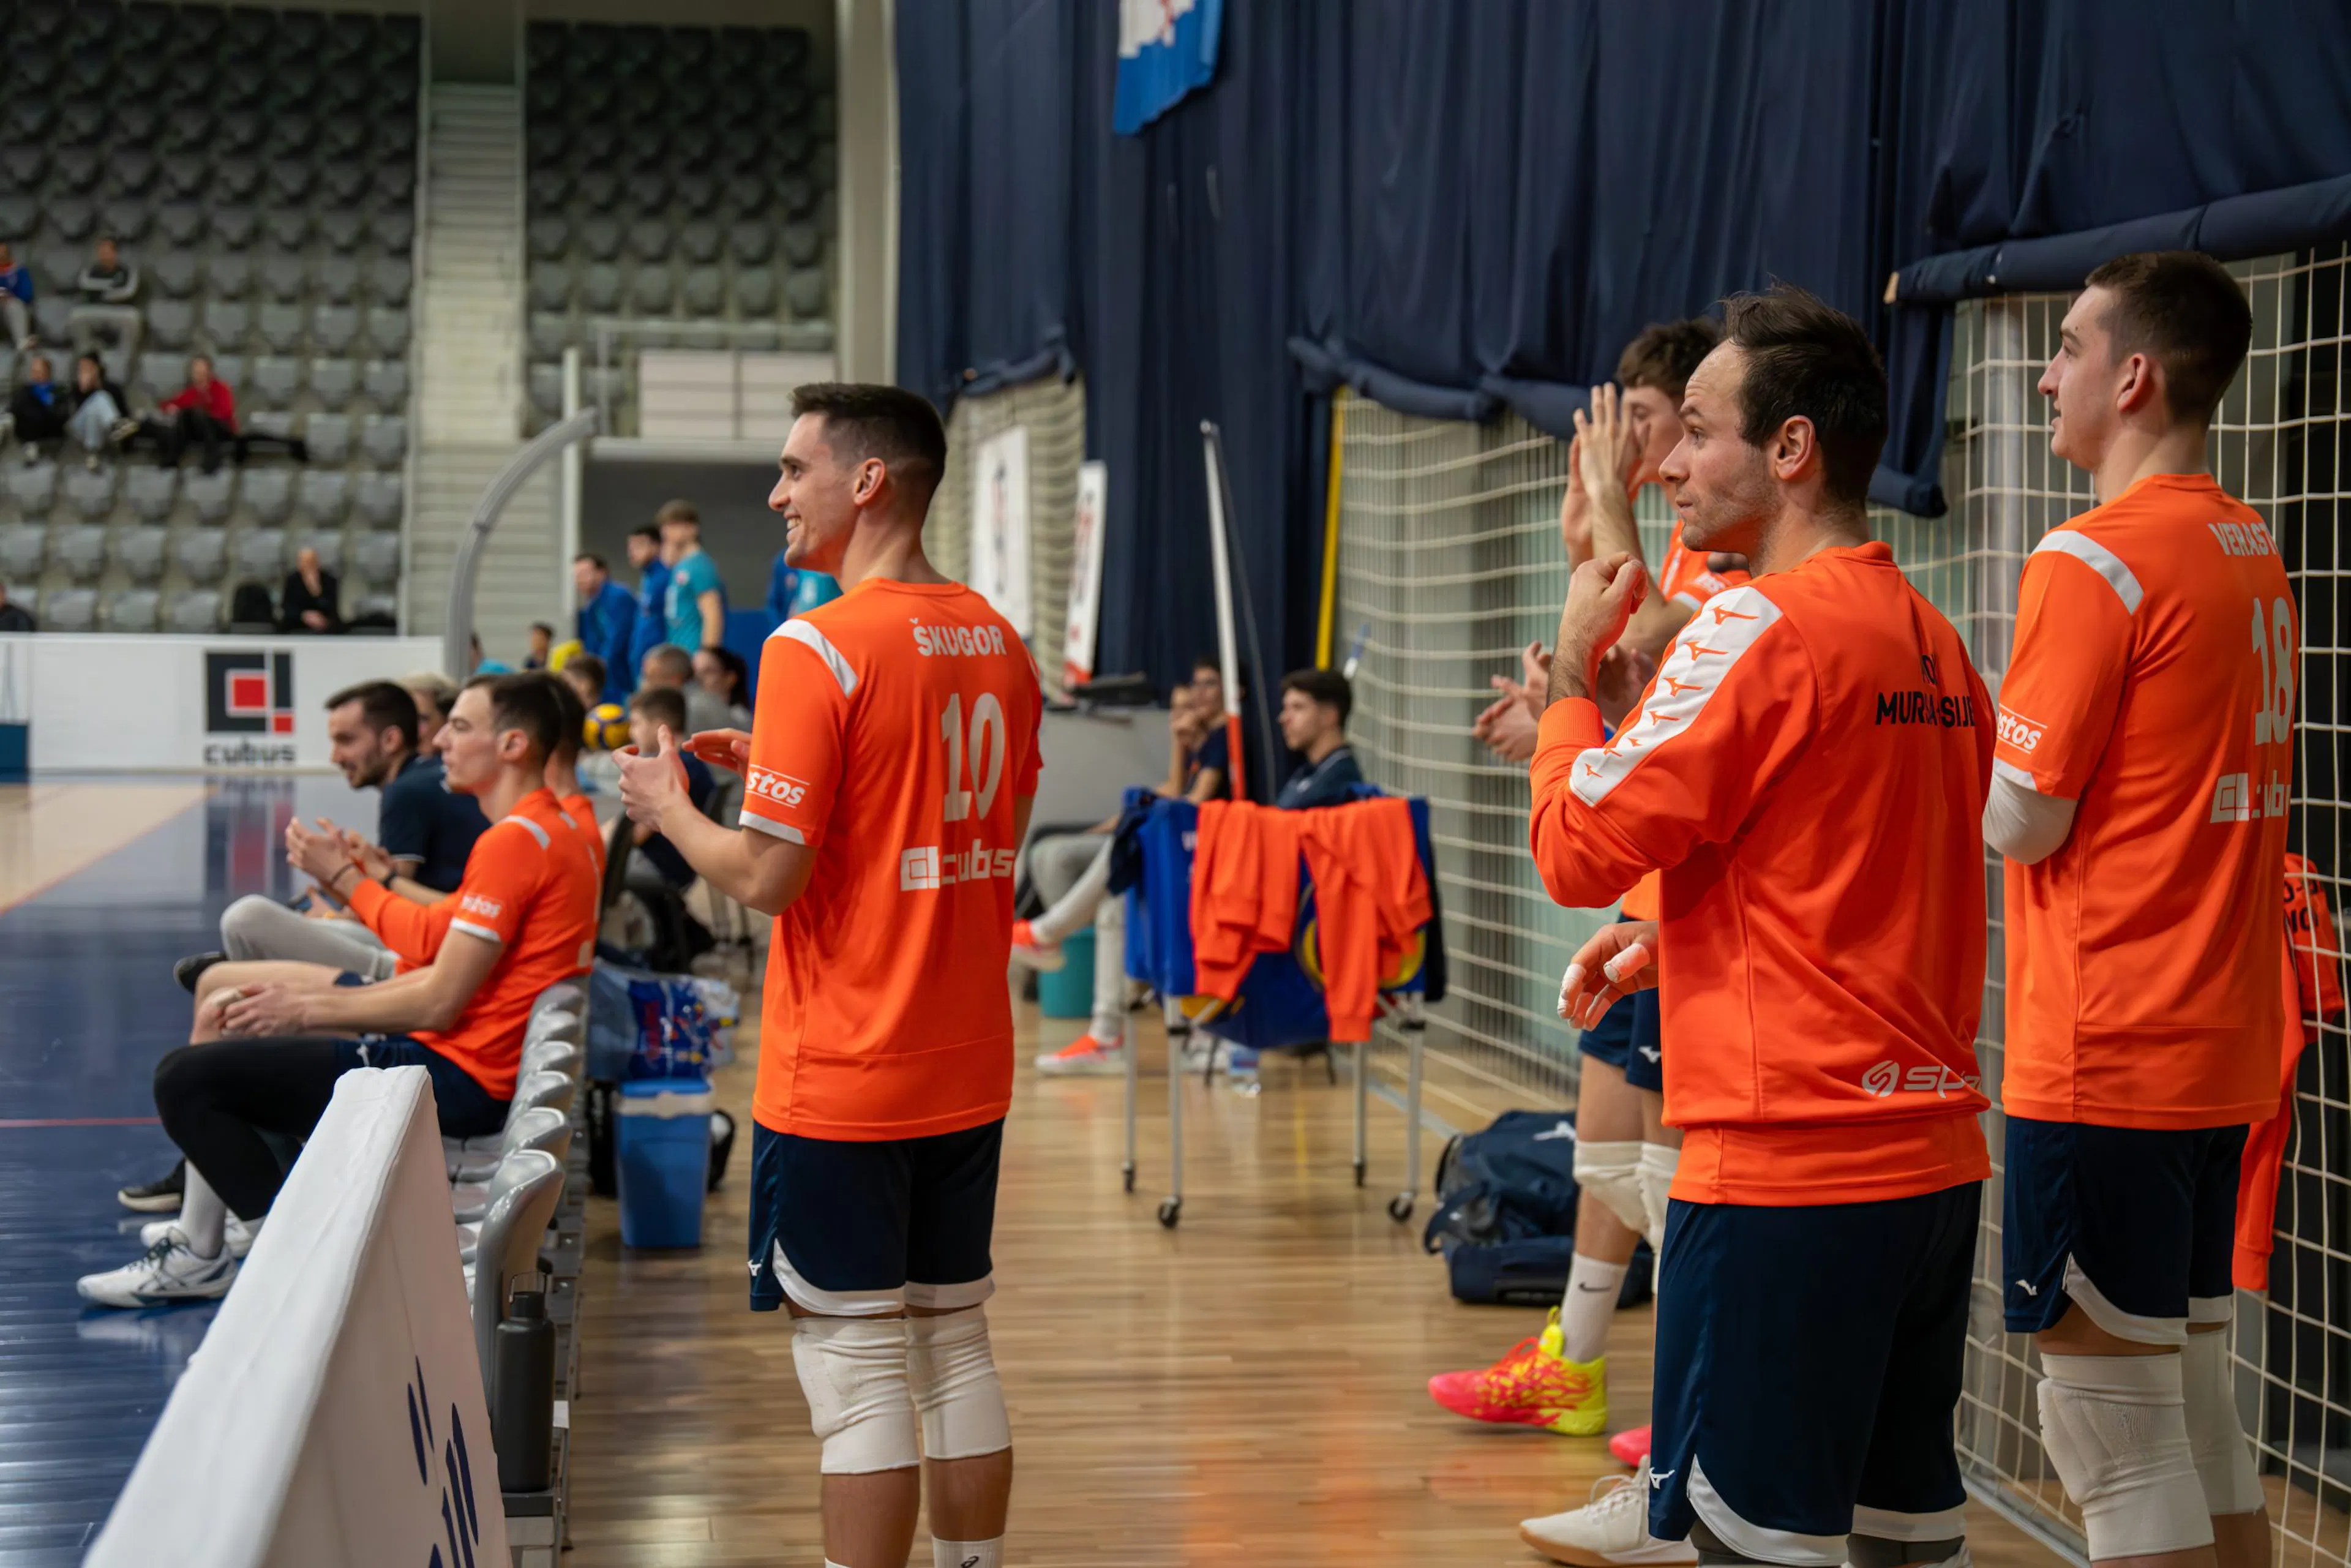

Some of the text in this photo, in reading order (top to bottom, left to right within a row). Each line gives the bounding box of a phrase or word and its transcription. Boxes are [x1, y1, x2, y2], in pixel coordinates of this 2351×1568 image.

[2207, 522, 2278, 557] VERAST
[909, 617, 1007, 656] ŠKUGOR
[2251, 596, 2293, 746] 18
[1997, 712, 2042, 751] stos
[941, 692, 1006, 823] 10
[746, 771, 806, 805] stos
